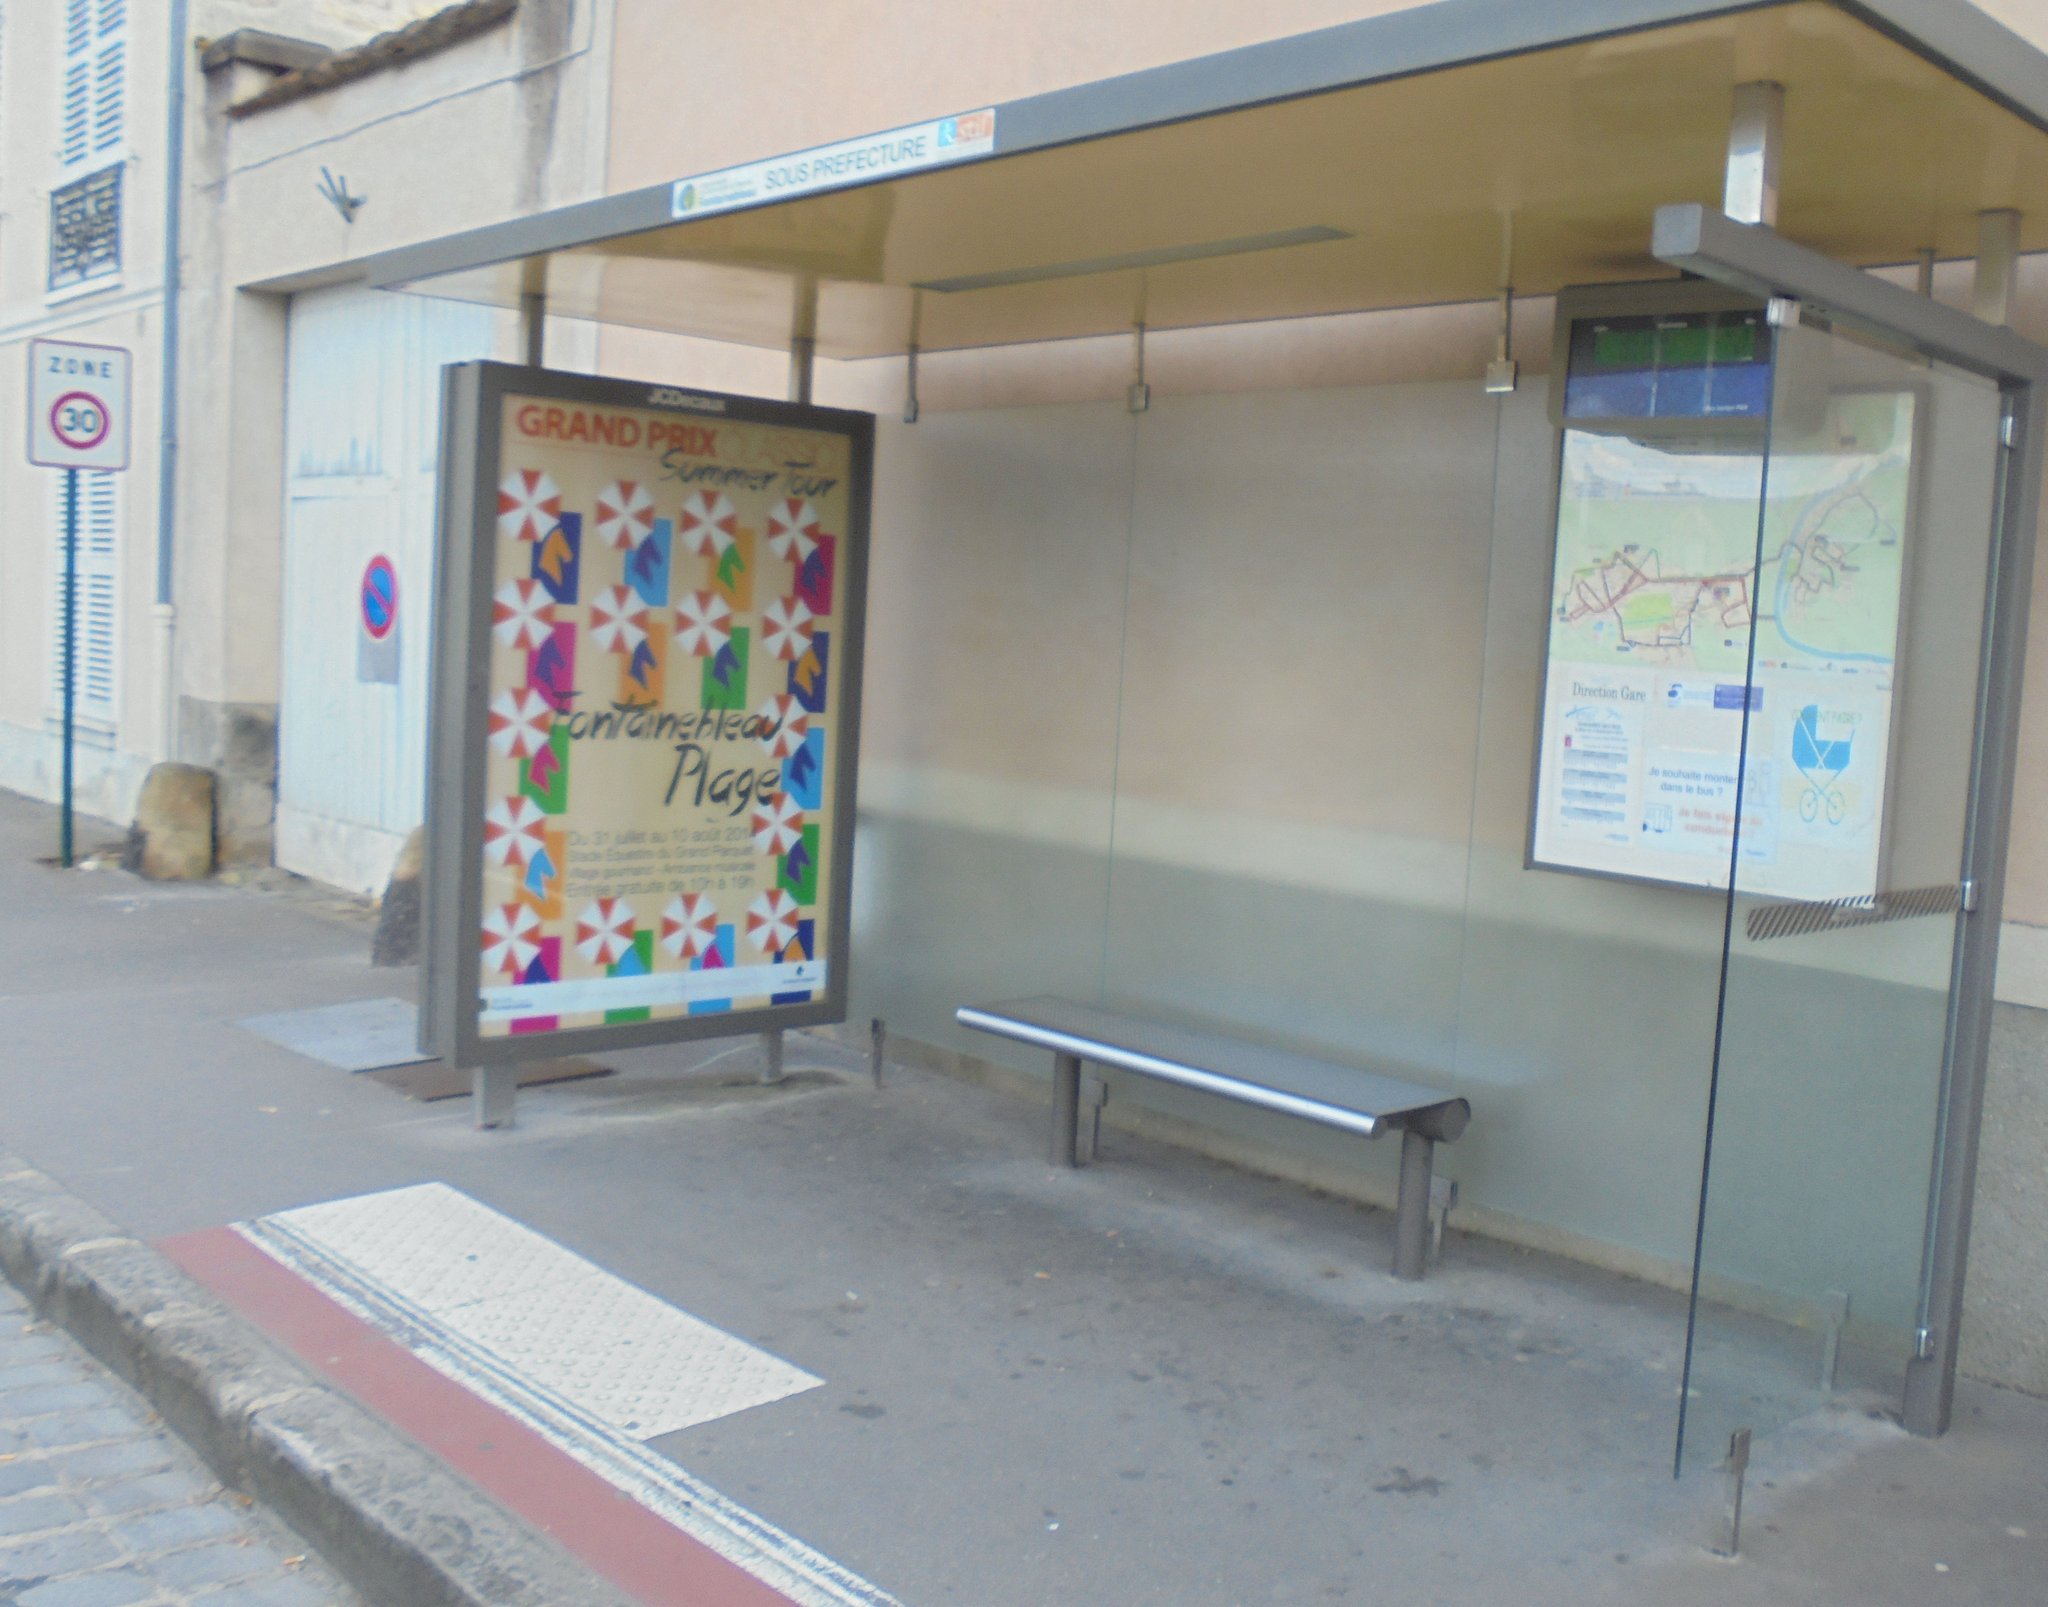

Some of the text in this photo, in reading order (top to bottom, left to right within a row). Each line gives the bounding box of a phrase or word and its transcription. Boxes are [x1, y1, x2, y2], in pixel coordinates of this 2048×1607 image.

[763, 135, 927, 192] SOUS PREFECTURE
[47, 355, 113, 379] ZONE
[62, 407, 99, 434] 30
[515, 403, 642, 449] GRAND
[647, 419, 719, 458] PRIX
[659, 447, 839, 497] Summer Tour
[1573, 681, 1647, 703] Direction Gare
[552, 690, 784, 742] Fontainebleau
[663, 742, 781, 818] Plage
[1648, 765, 1660, 777] Je
[1662, 767, 1702, 781] souhaite
[1660, 781, 1683, 793] dans
[1685, 782, 1695, 794] le
[1697, 783, 1715, 797] bus
